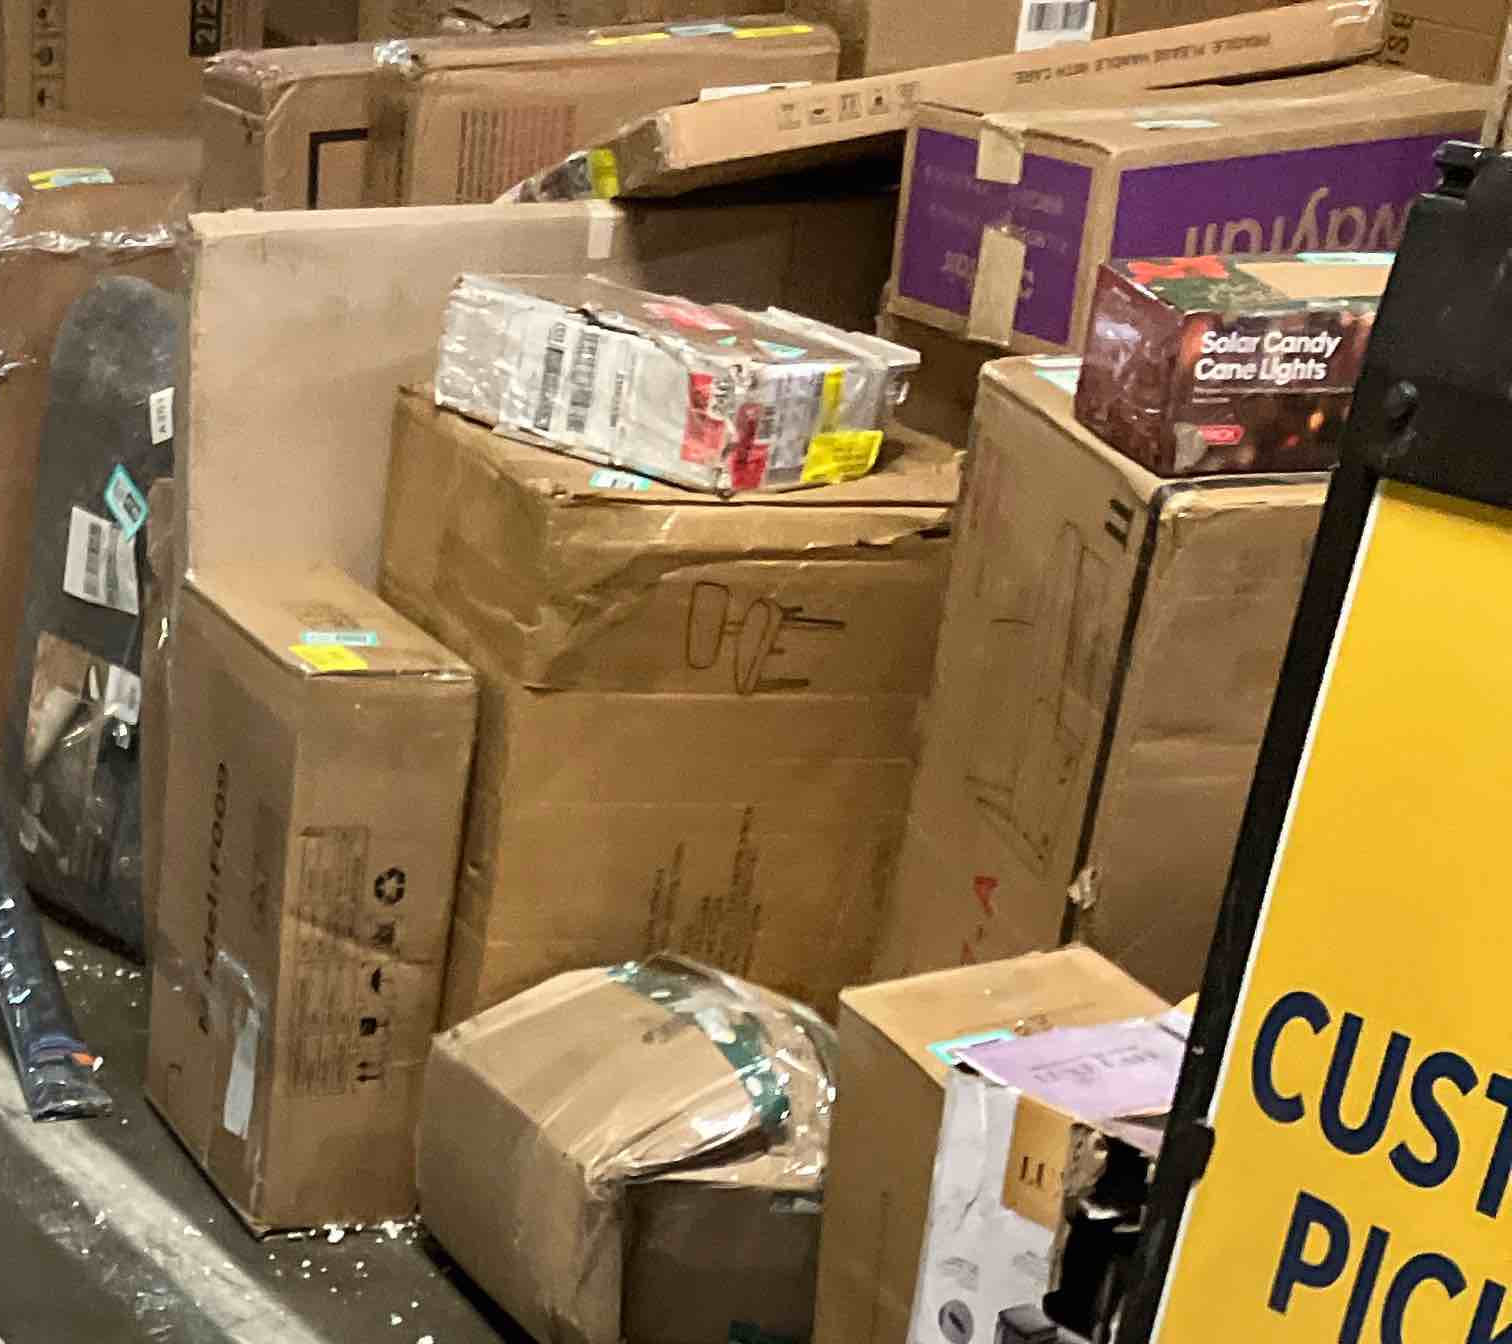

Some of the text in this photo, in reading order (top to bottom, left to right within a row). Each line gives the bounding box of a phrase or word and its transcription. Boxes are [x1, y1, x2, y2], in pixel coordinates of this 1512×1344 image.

[1201, 330, 1342, 359] Solar Candy
[1194, 357, 1328, 386] Cane Lights
